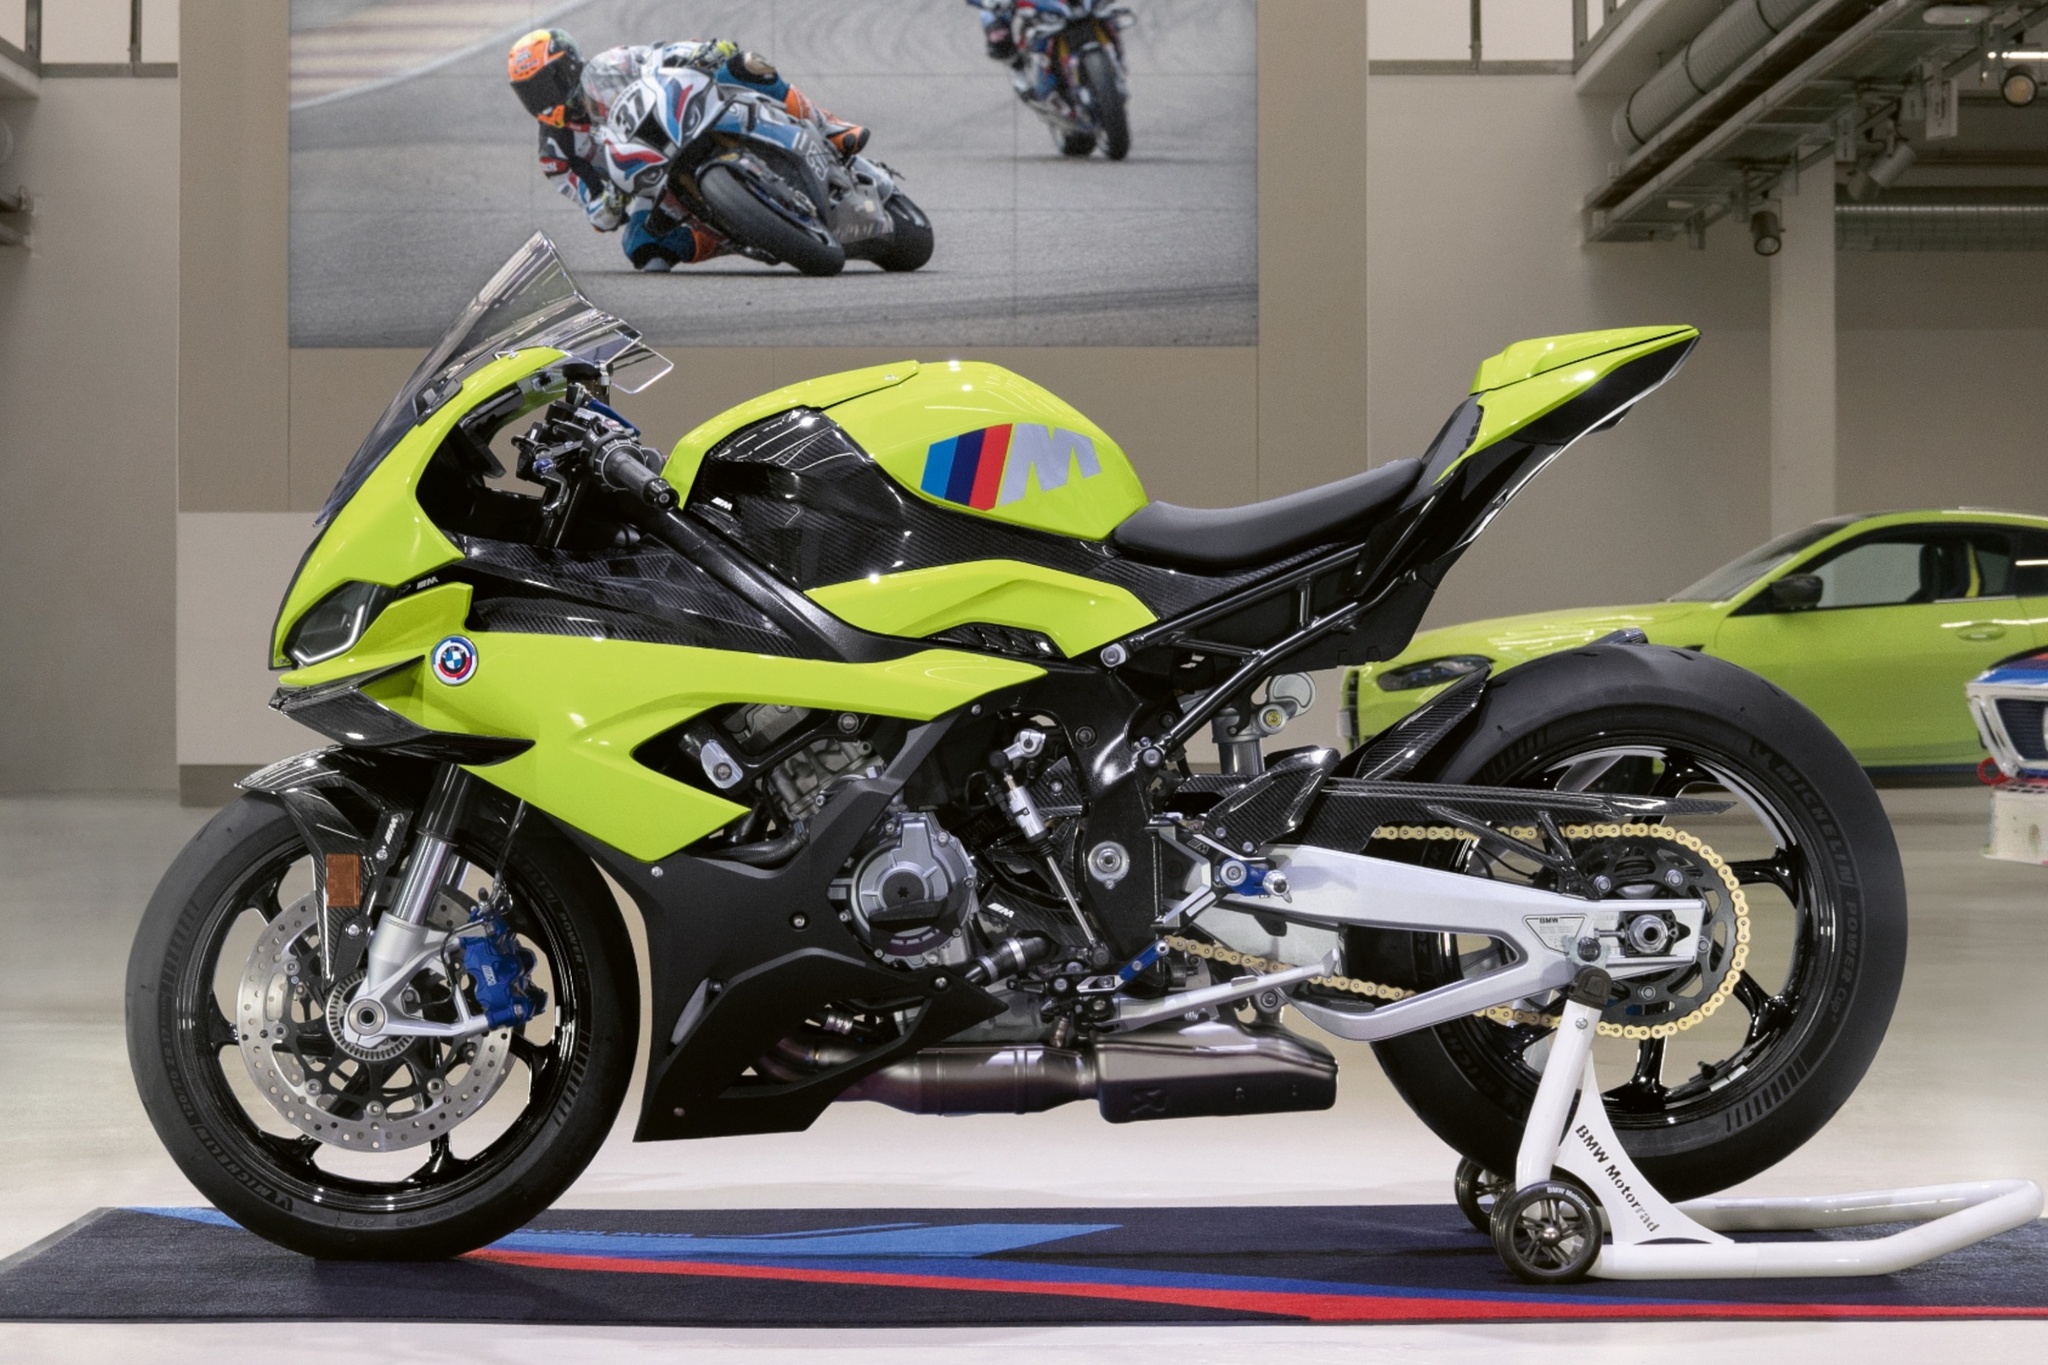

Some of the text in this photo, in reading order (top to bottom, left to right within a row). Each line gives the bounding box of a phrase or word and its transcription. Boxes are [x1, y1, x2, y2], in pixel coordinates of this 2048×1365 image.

[615, 88, 646, 140] 37
[1773, 760, 1854, 882] MICHELIN
[1841, 901, 1858, 983] POWER
[557, 911, 584, 964] POWER
[195, 1126, 273, 1198] MICHELIN
[1546, 1186, 1565, 1194] BMW
[1575, 1125, 1660, 1232] BMW Motorrad
